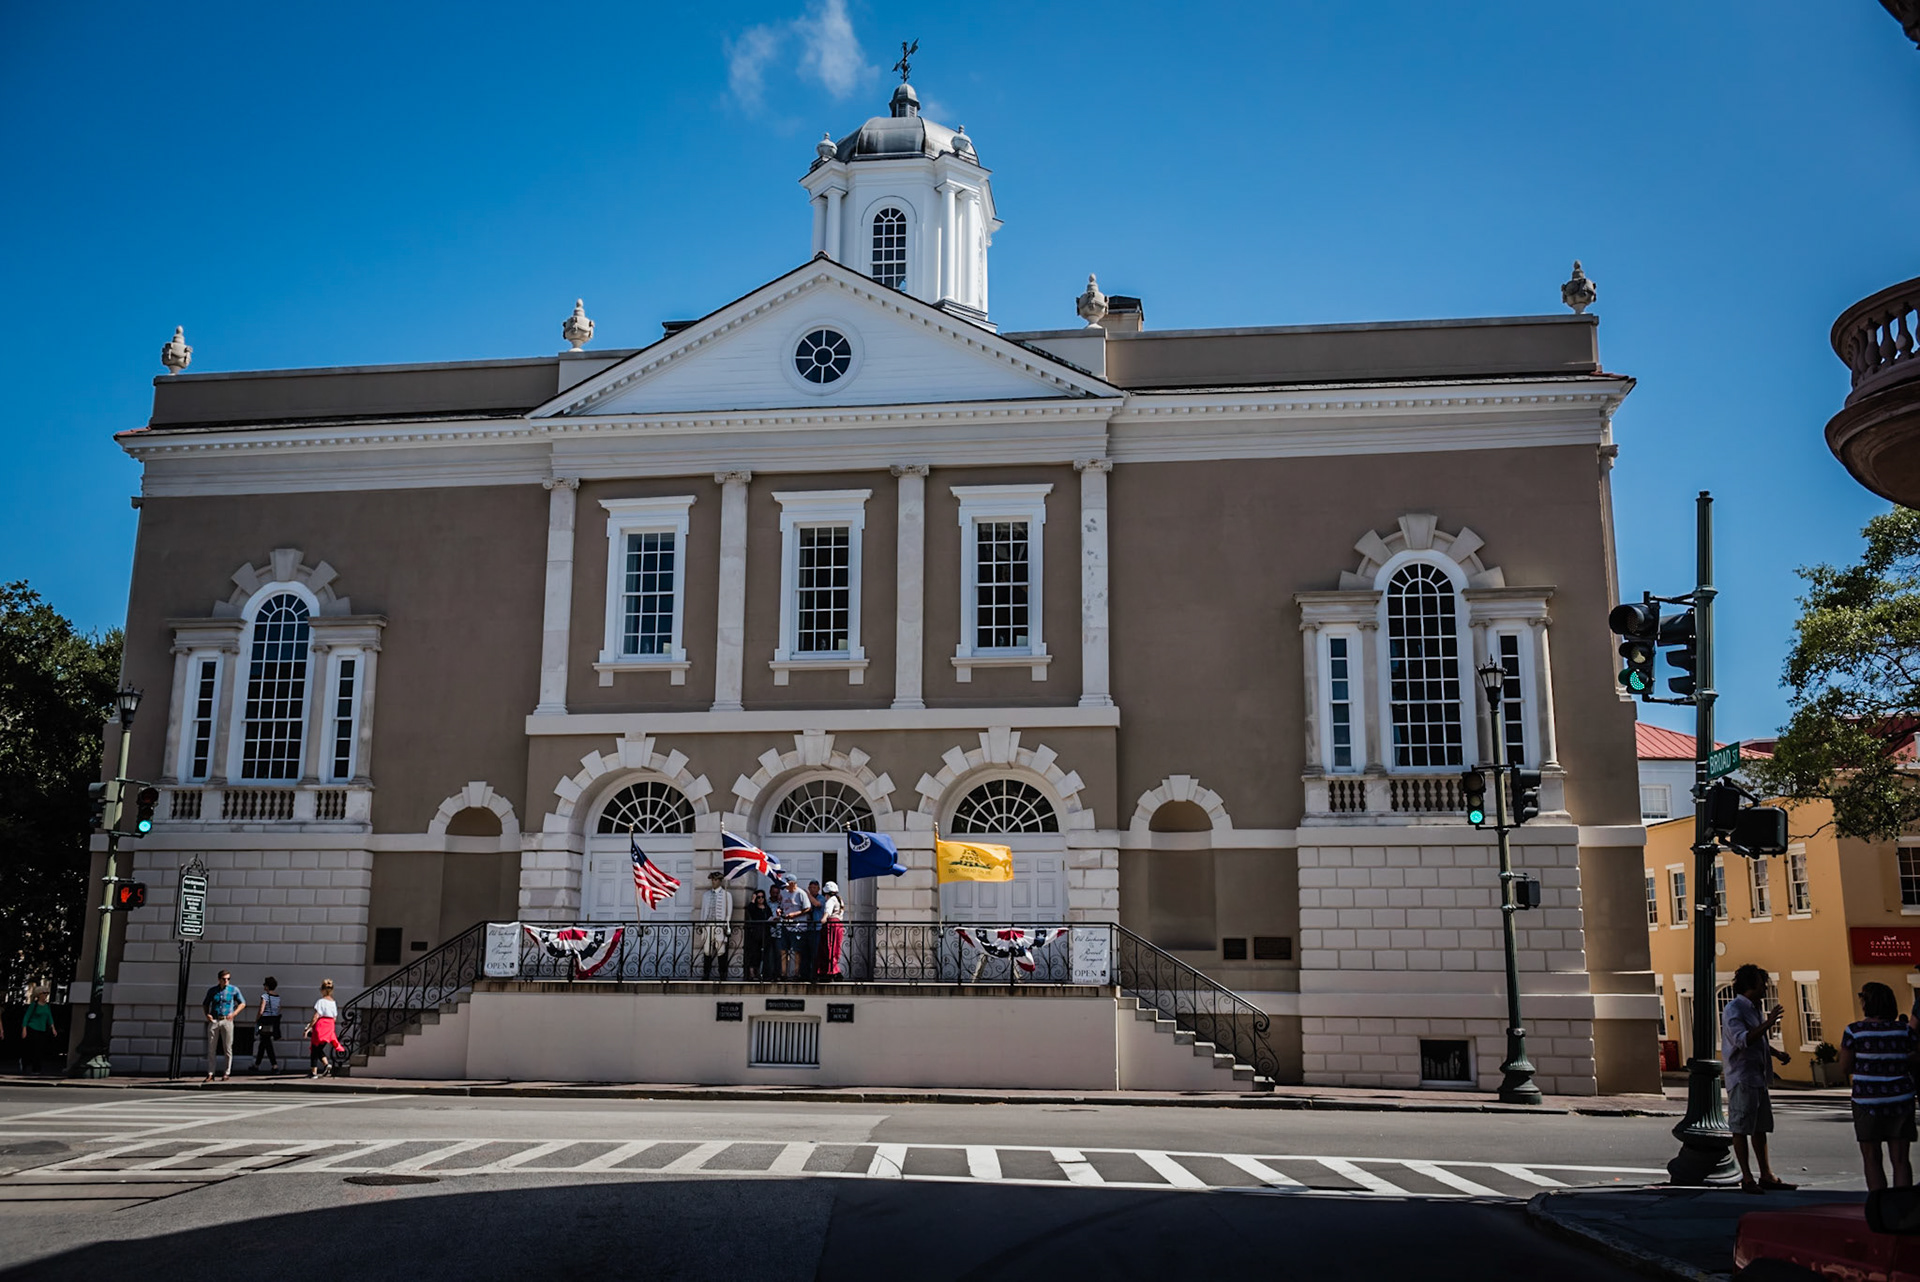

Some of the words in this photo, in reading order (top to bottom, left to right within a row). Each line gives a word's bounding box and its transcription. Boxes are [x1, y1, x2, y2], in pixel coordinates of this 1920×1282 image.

[1710, 749, 1731, 775] BROAD
[1732, 749, 1738, 763] ST
[137, 888, 144, 903] 5
